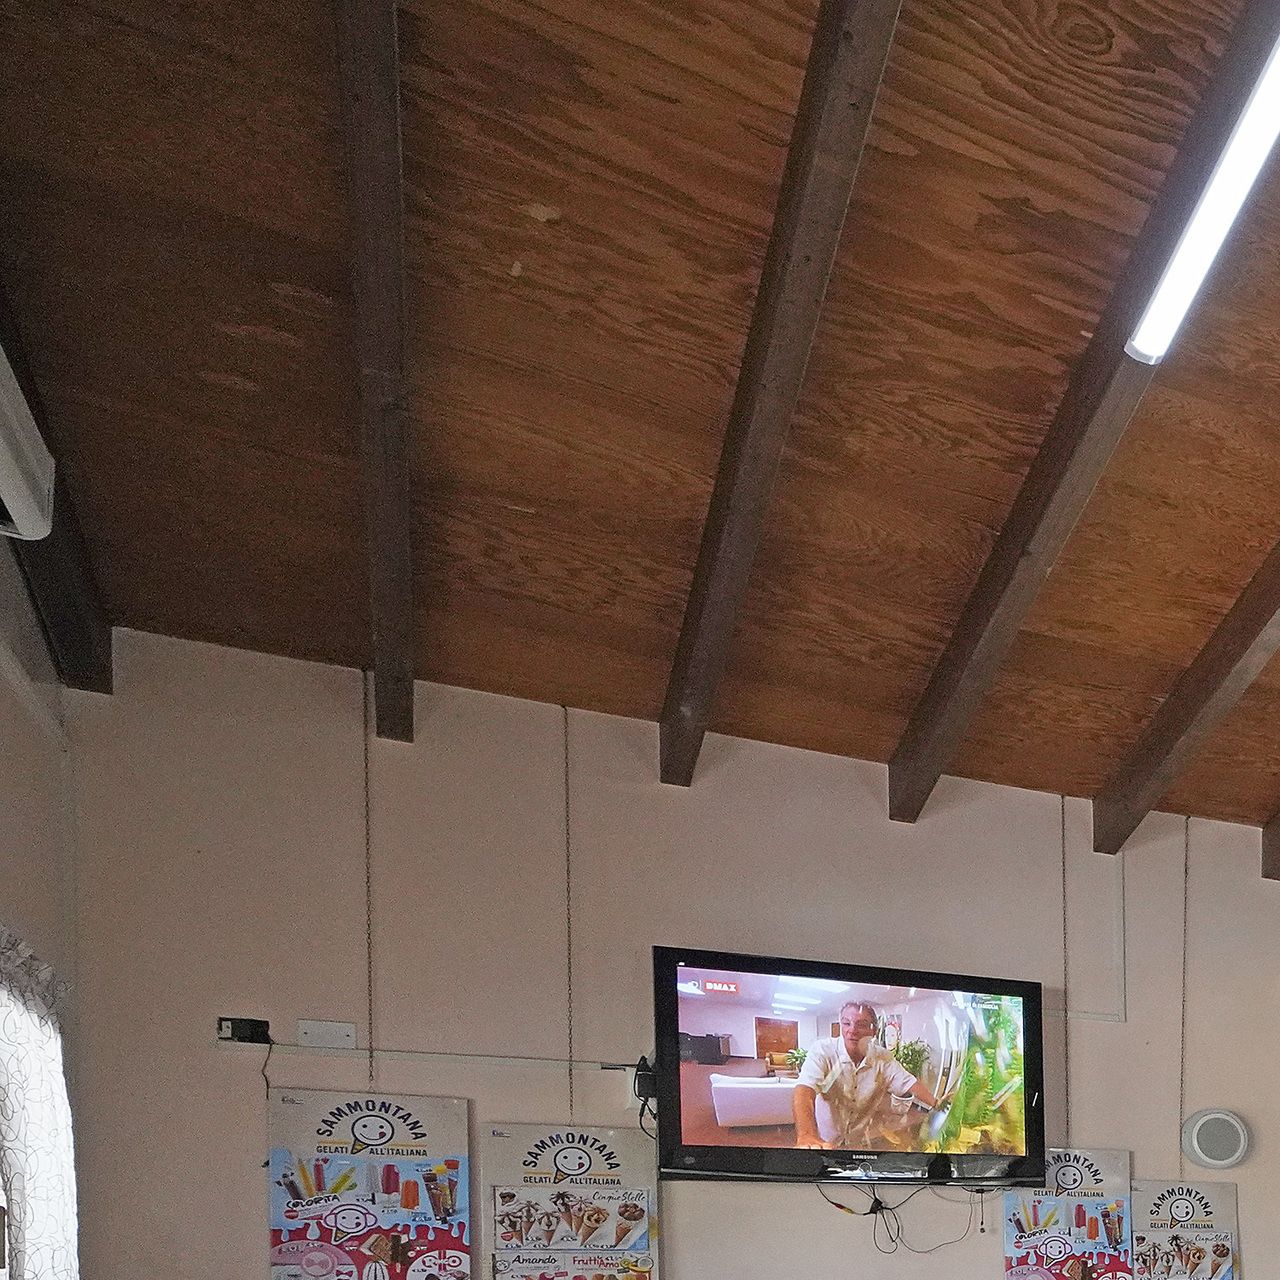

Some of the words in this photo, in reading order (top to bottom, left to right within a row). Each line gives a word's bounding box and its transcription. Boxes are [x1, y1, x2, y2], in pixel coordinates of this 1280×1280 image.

[705, 982, 737, 992] DMAX
[316, 1099, 428, 1141] SAMMONTANA
[316, 1145, 349, 1155] GELATI
[369, 1147, 428, 1157] ALL'ITALIANA
[522, 1132, 621, 1171] SAMMONTANA
[1044, 1152, 1104, 1185] MMONTANA
[523, 1176, 551, 1184] GELATI
[569, 1176, 622, 1186] ALL'ITALIANA
[1033, 1189, 1054, 1197] GELATI
[1149, 1186, 1214, 1217] SAMMONTANA
[511, 1254, 558, 1266] Amando
